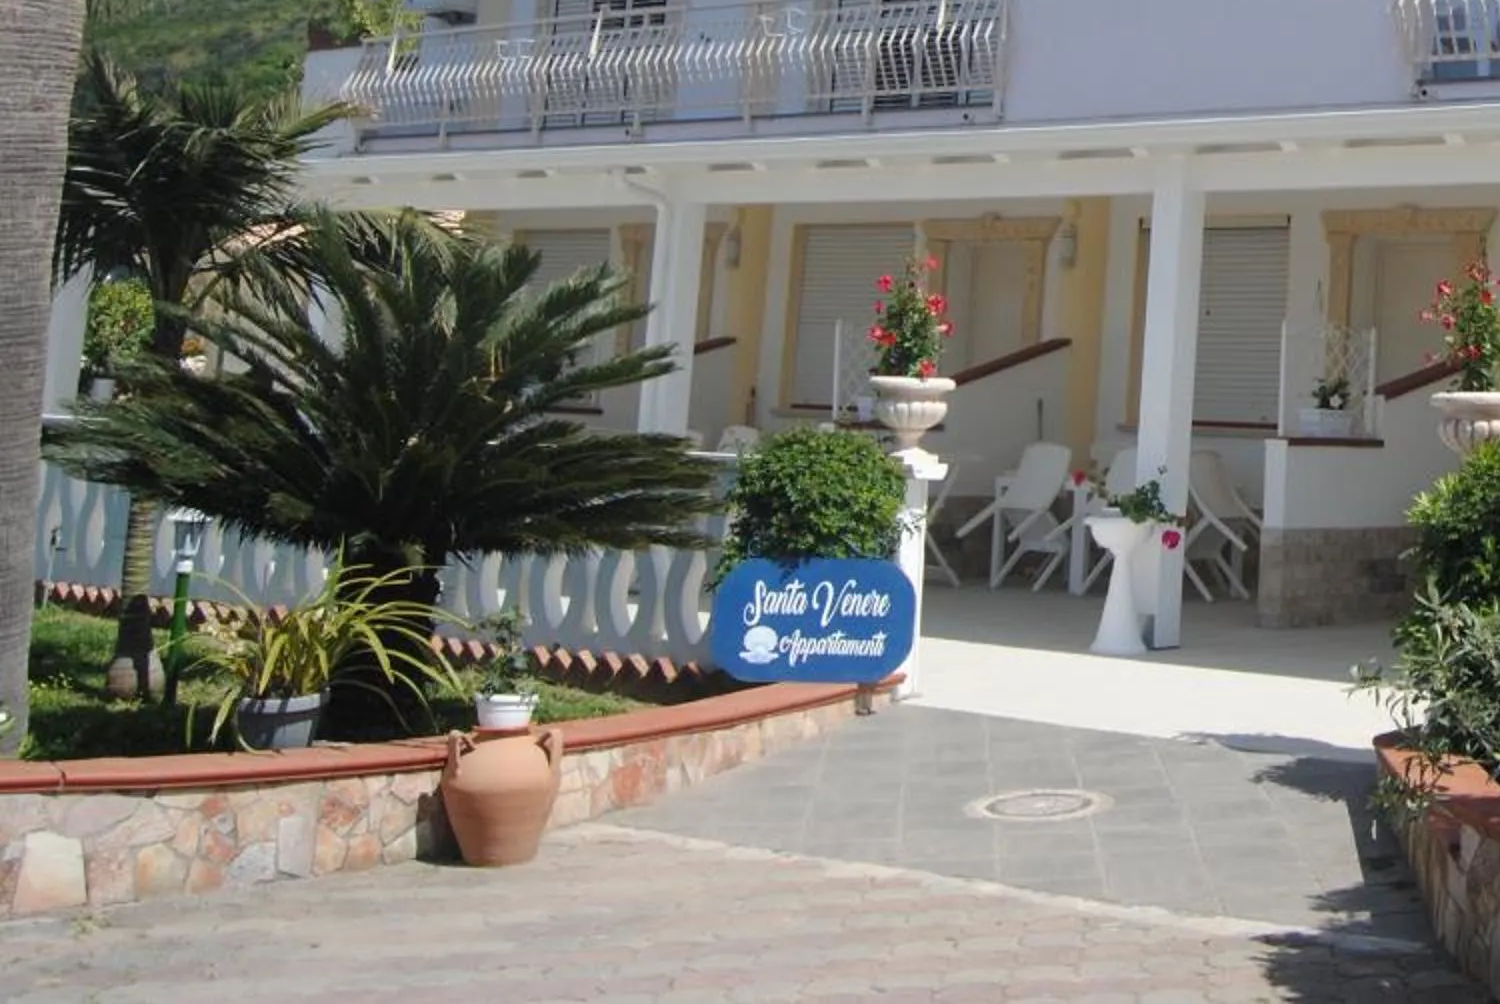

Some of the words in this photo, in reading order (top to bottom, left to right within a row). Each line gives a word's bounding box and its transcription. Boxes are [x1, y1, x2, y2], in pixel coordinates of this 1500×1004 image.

[744, 579, 808, 626] Santa
[813, 579, 891, 627] Venere
[780, 629, 887, 667] Appartamenti
